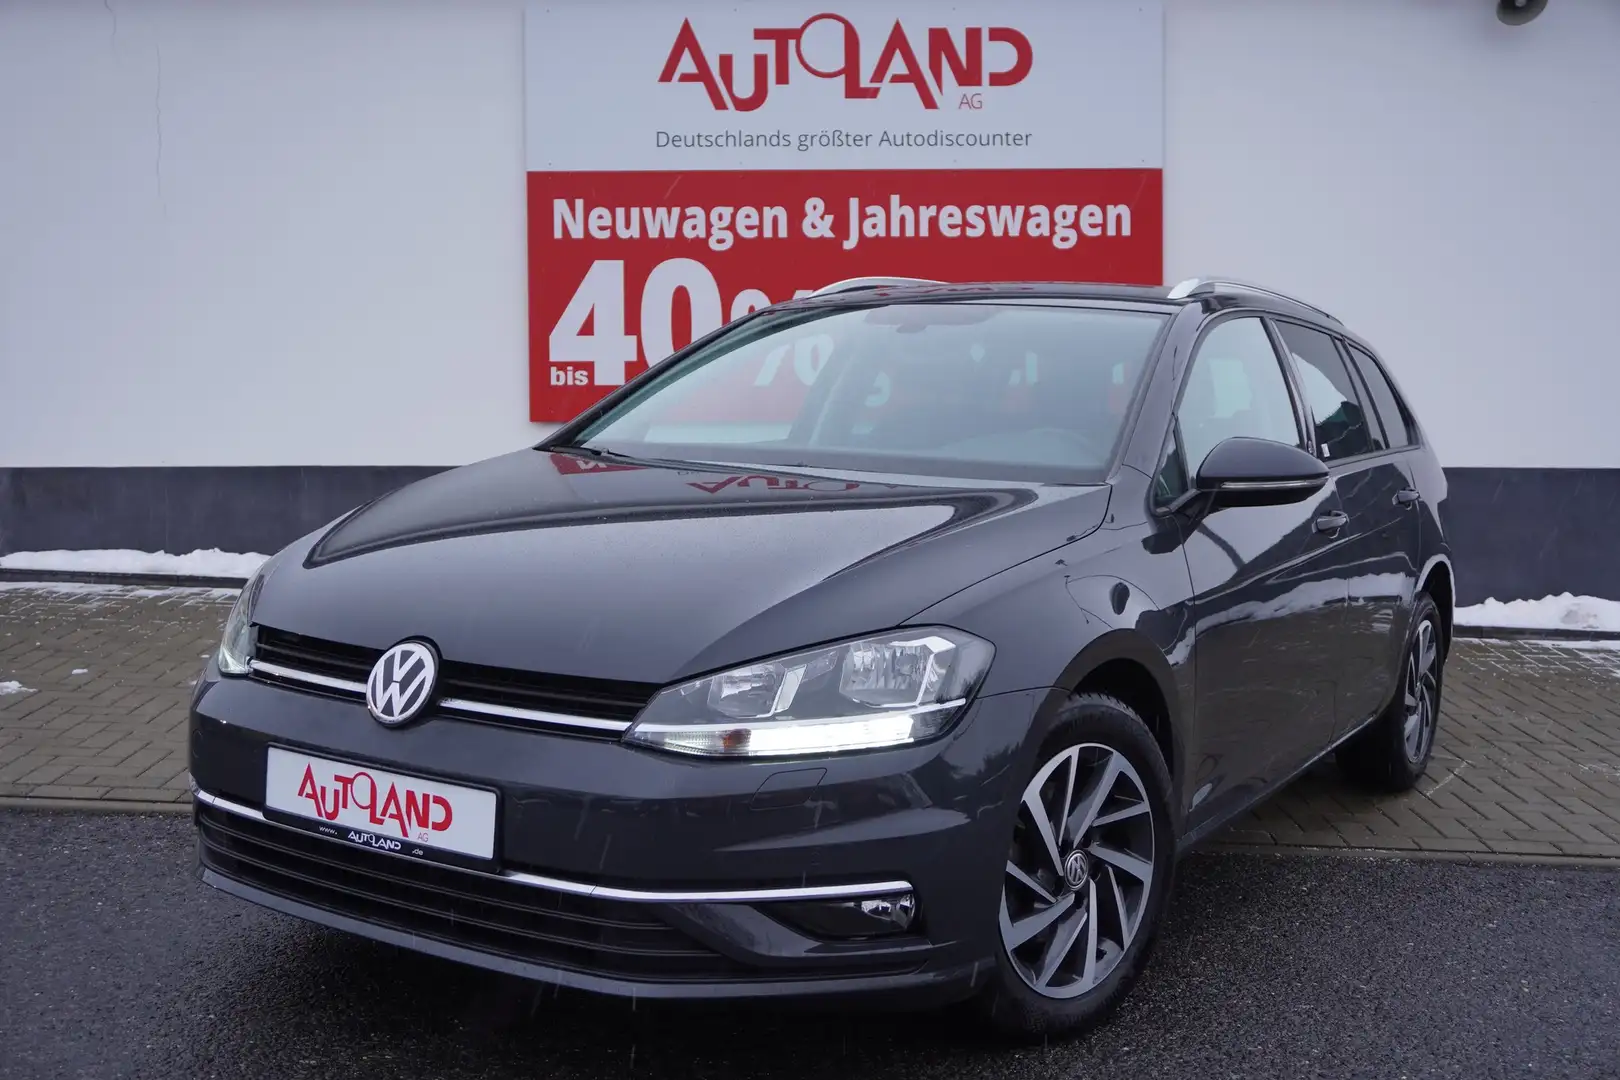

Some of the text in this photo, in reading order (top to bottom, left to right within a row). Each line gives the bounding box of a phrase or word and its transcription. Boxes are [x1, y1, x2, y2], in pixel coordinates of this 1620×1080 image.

[958, 93, 983, 110] AG
[656, 129, 1032, 152] Deutschlands größter Autodiscounter
[553, 194, 1132, 252] Neuwagen & Jahreswagen
[550, 366, 589, 387] bis
[367, 641, 436, 722] VW
[417, 832, 429, 842] AG
